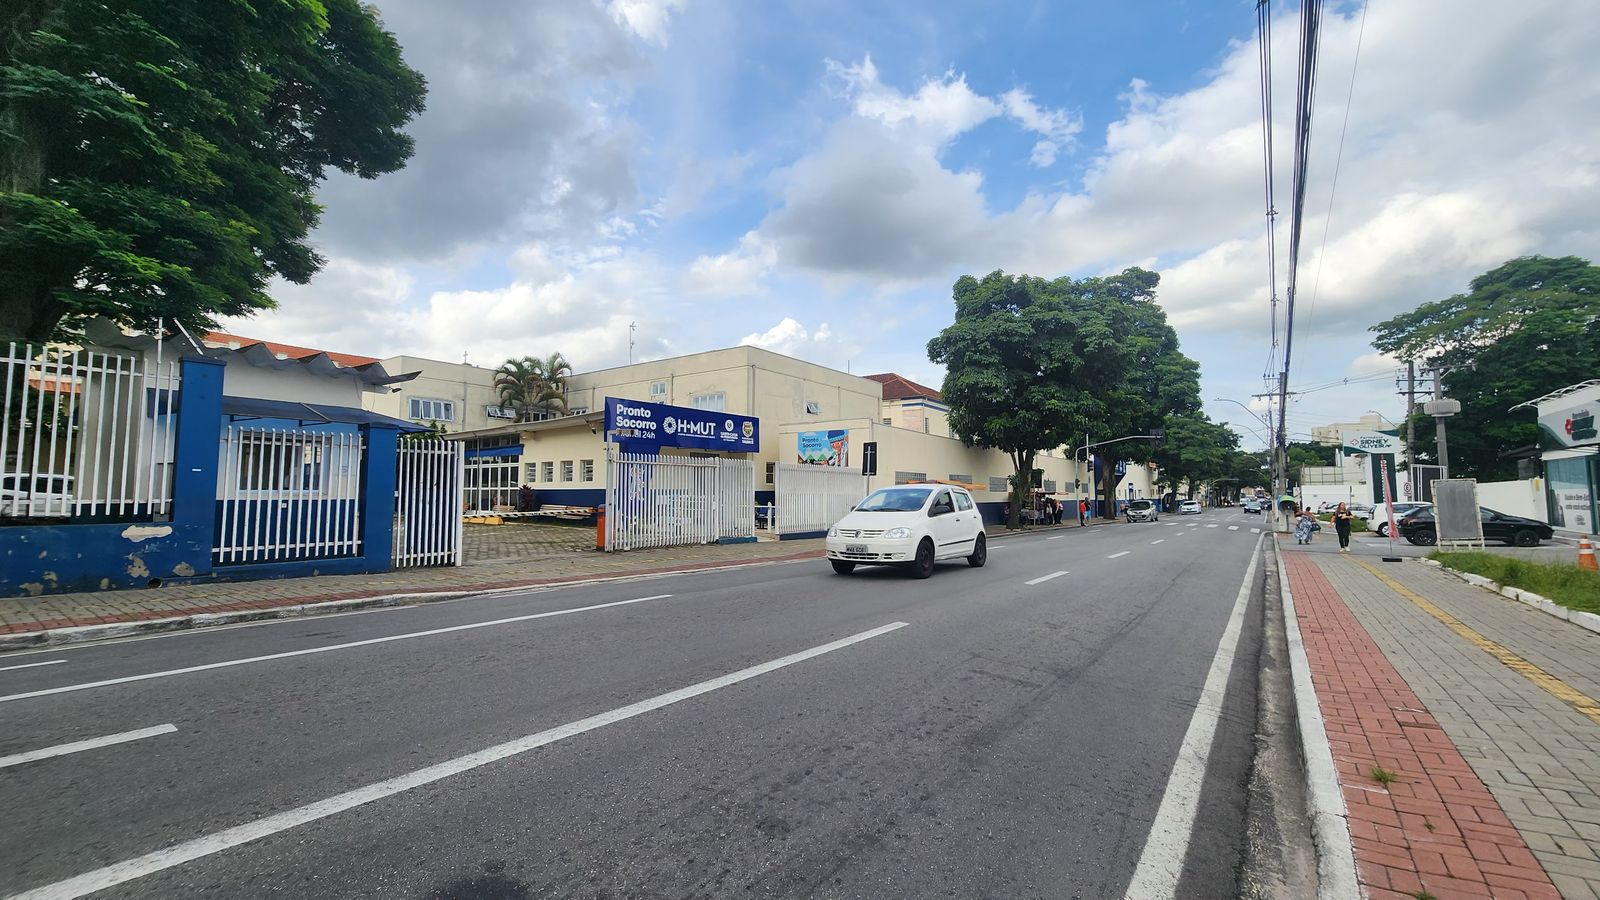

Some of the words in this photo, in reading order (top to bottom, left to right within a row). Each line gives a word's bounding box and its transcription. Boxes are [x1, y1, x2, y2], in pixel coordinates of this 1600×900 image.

[616, 403, 651, 417] Pronto
[615, 415, 657, 430] Socorro
[642, 430, 656, 440] 24h
